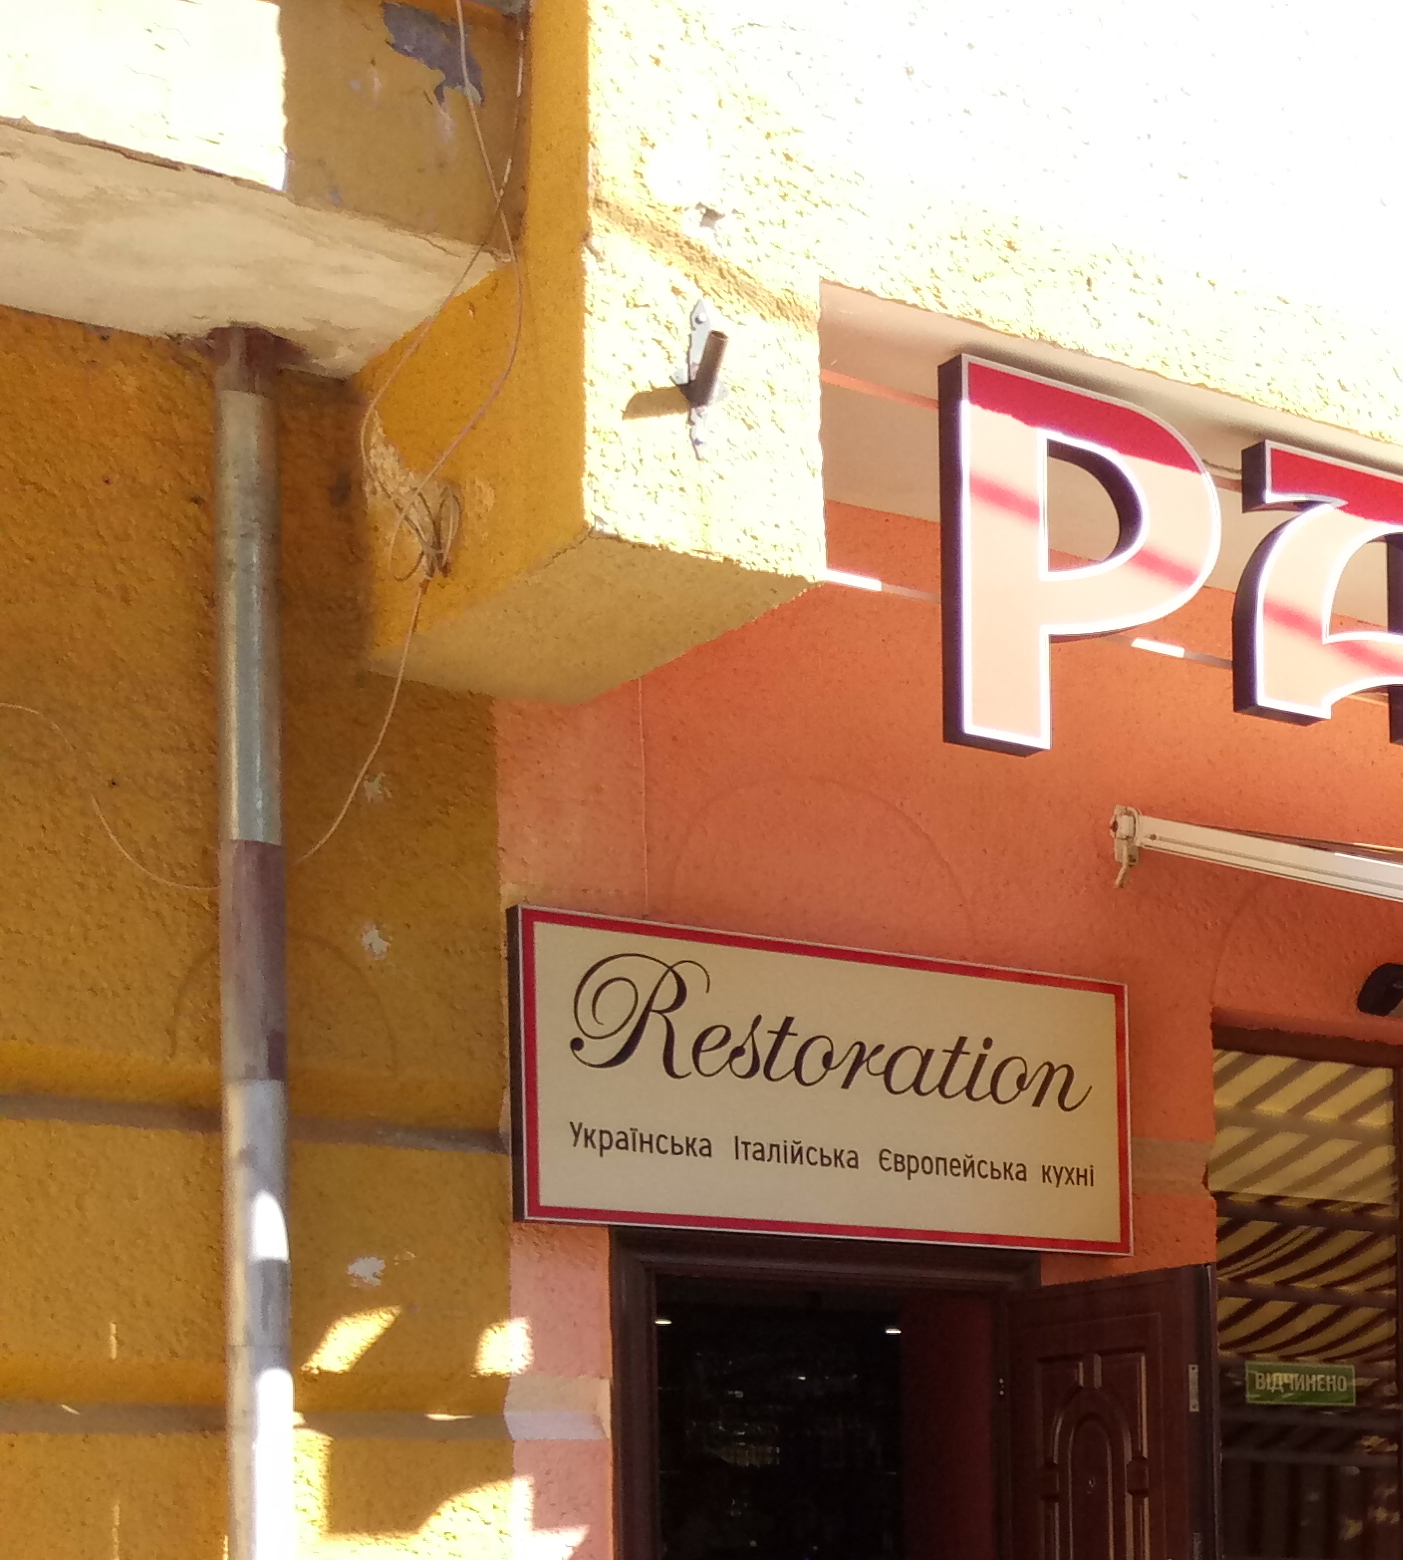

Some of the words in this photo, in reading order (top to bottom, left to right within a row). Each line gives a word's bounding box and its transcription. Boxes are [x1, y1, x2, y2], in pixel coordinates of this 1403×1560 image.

[569, 952, 1092, 1113] Restoration
[569, 1121, 713, 1163] Українська
[733, 1135, 859, 1170] Італійська
[878, 1147, 1028, 1183] Європейська
[1041, 1161, 1096, 1188] кухні
[1255, 1371, 1348, 1394] ВІДЧИНЕНО
